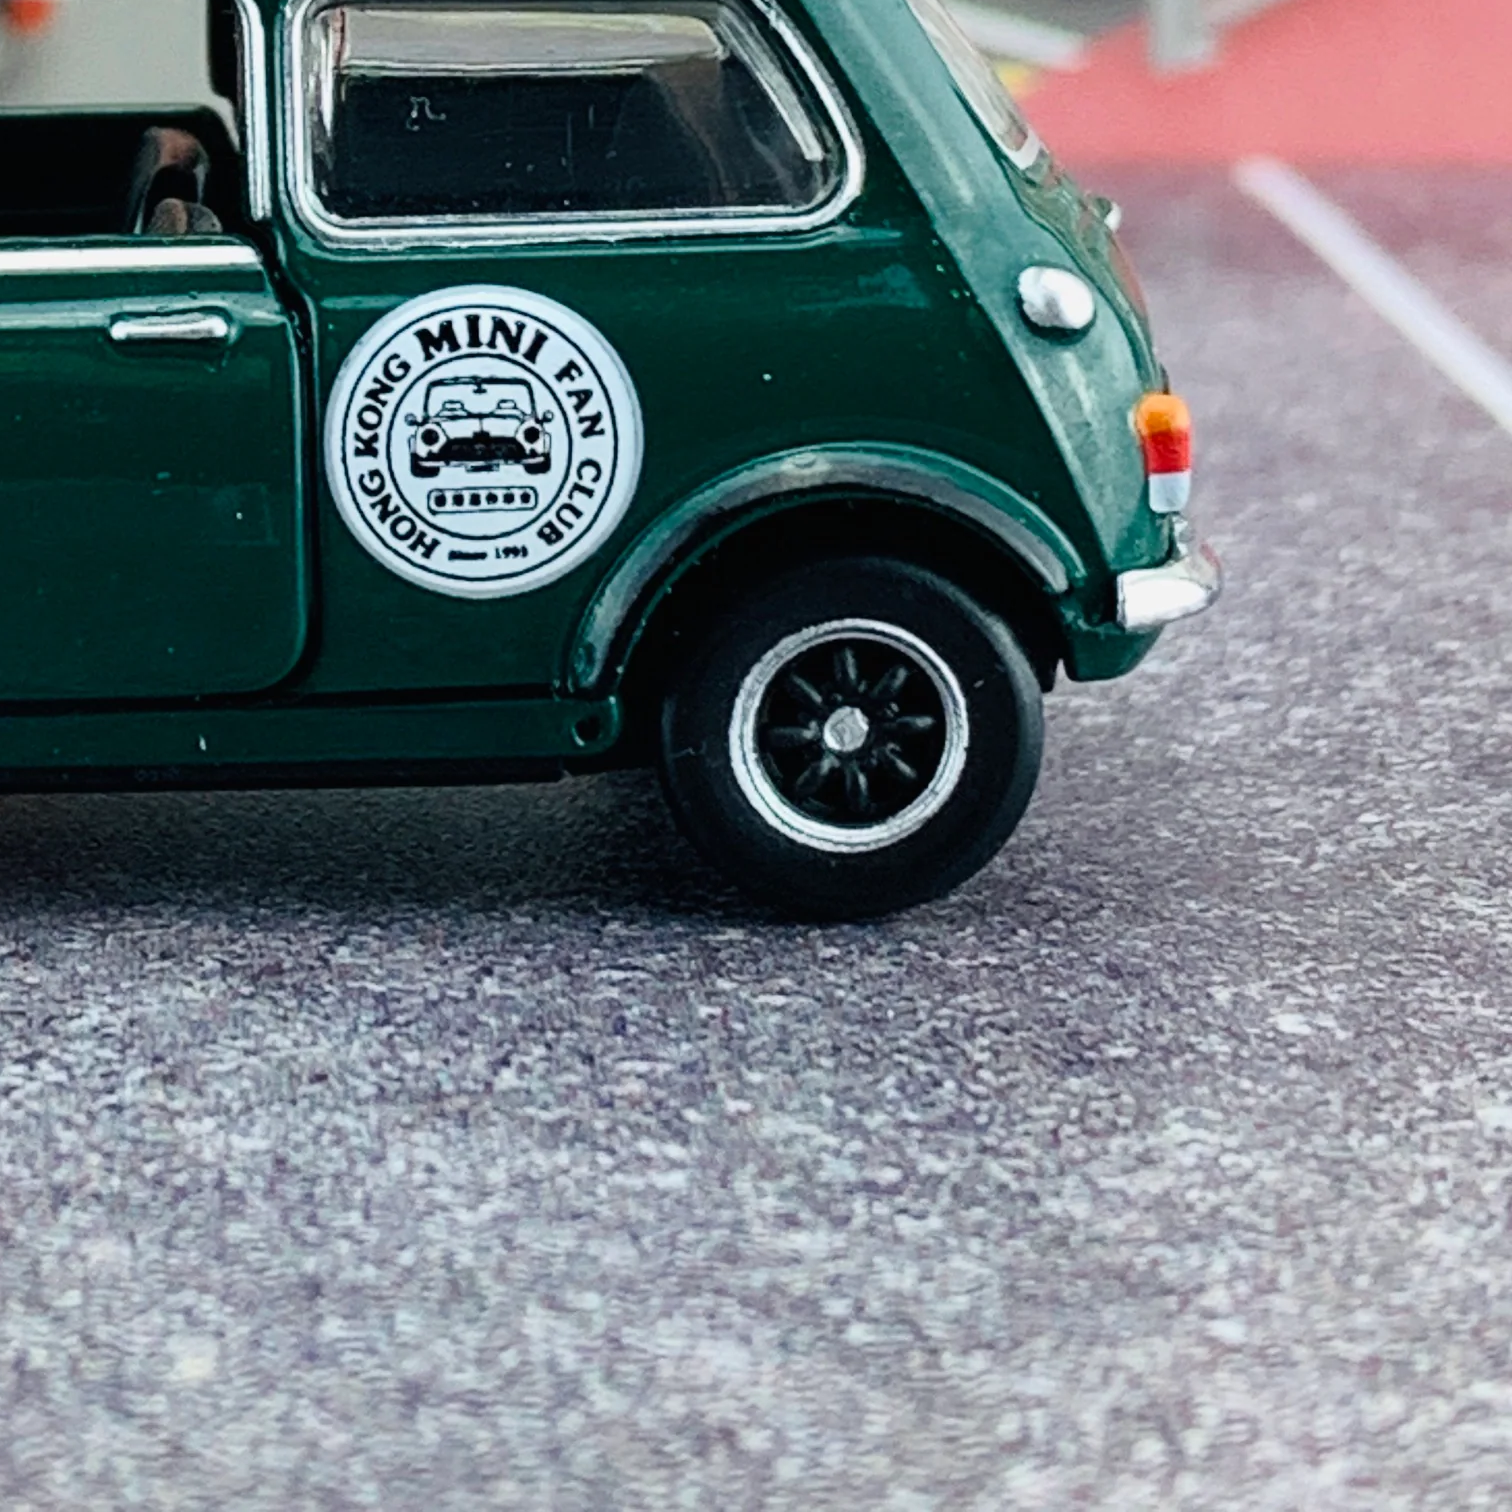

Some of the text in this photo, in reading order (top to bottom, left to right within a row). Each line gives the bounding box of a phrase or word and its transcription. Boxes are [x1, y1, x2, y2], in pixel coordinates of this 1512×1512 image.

[354, 314, 605, 560] HONG KONG MINI FAN CLUB
